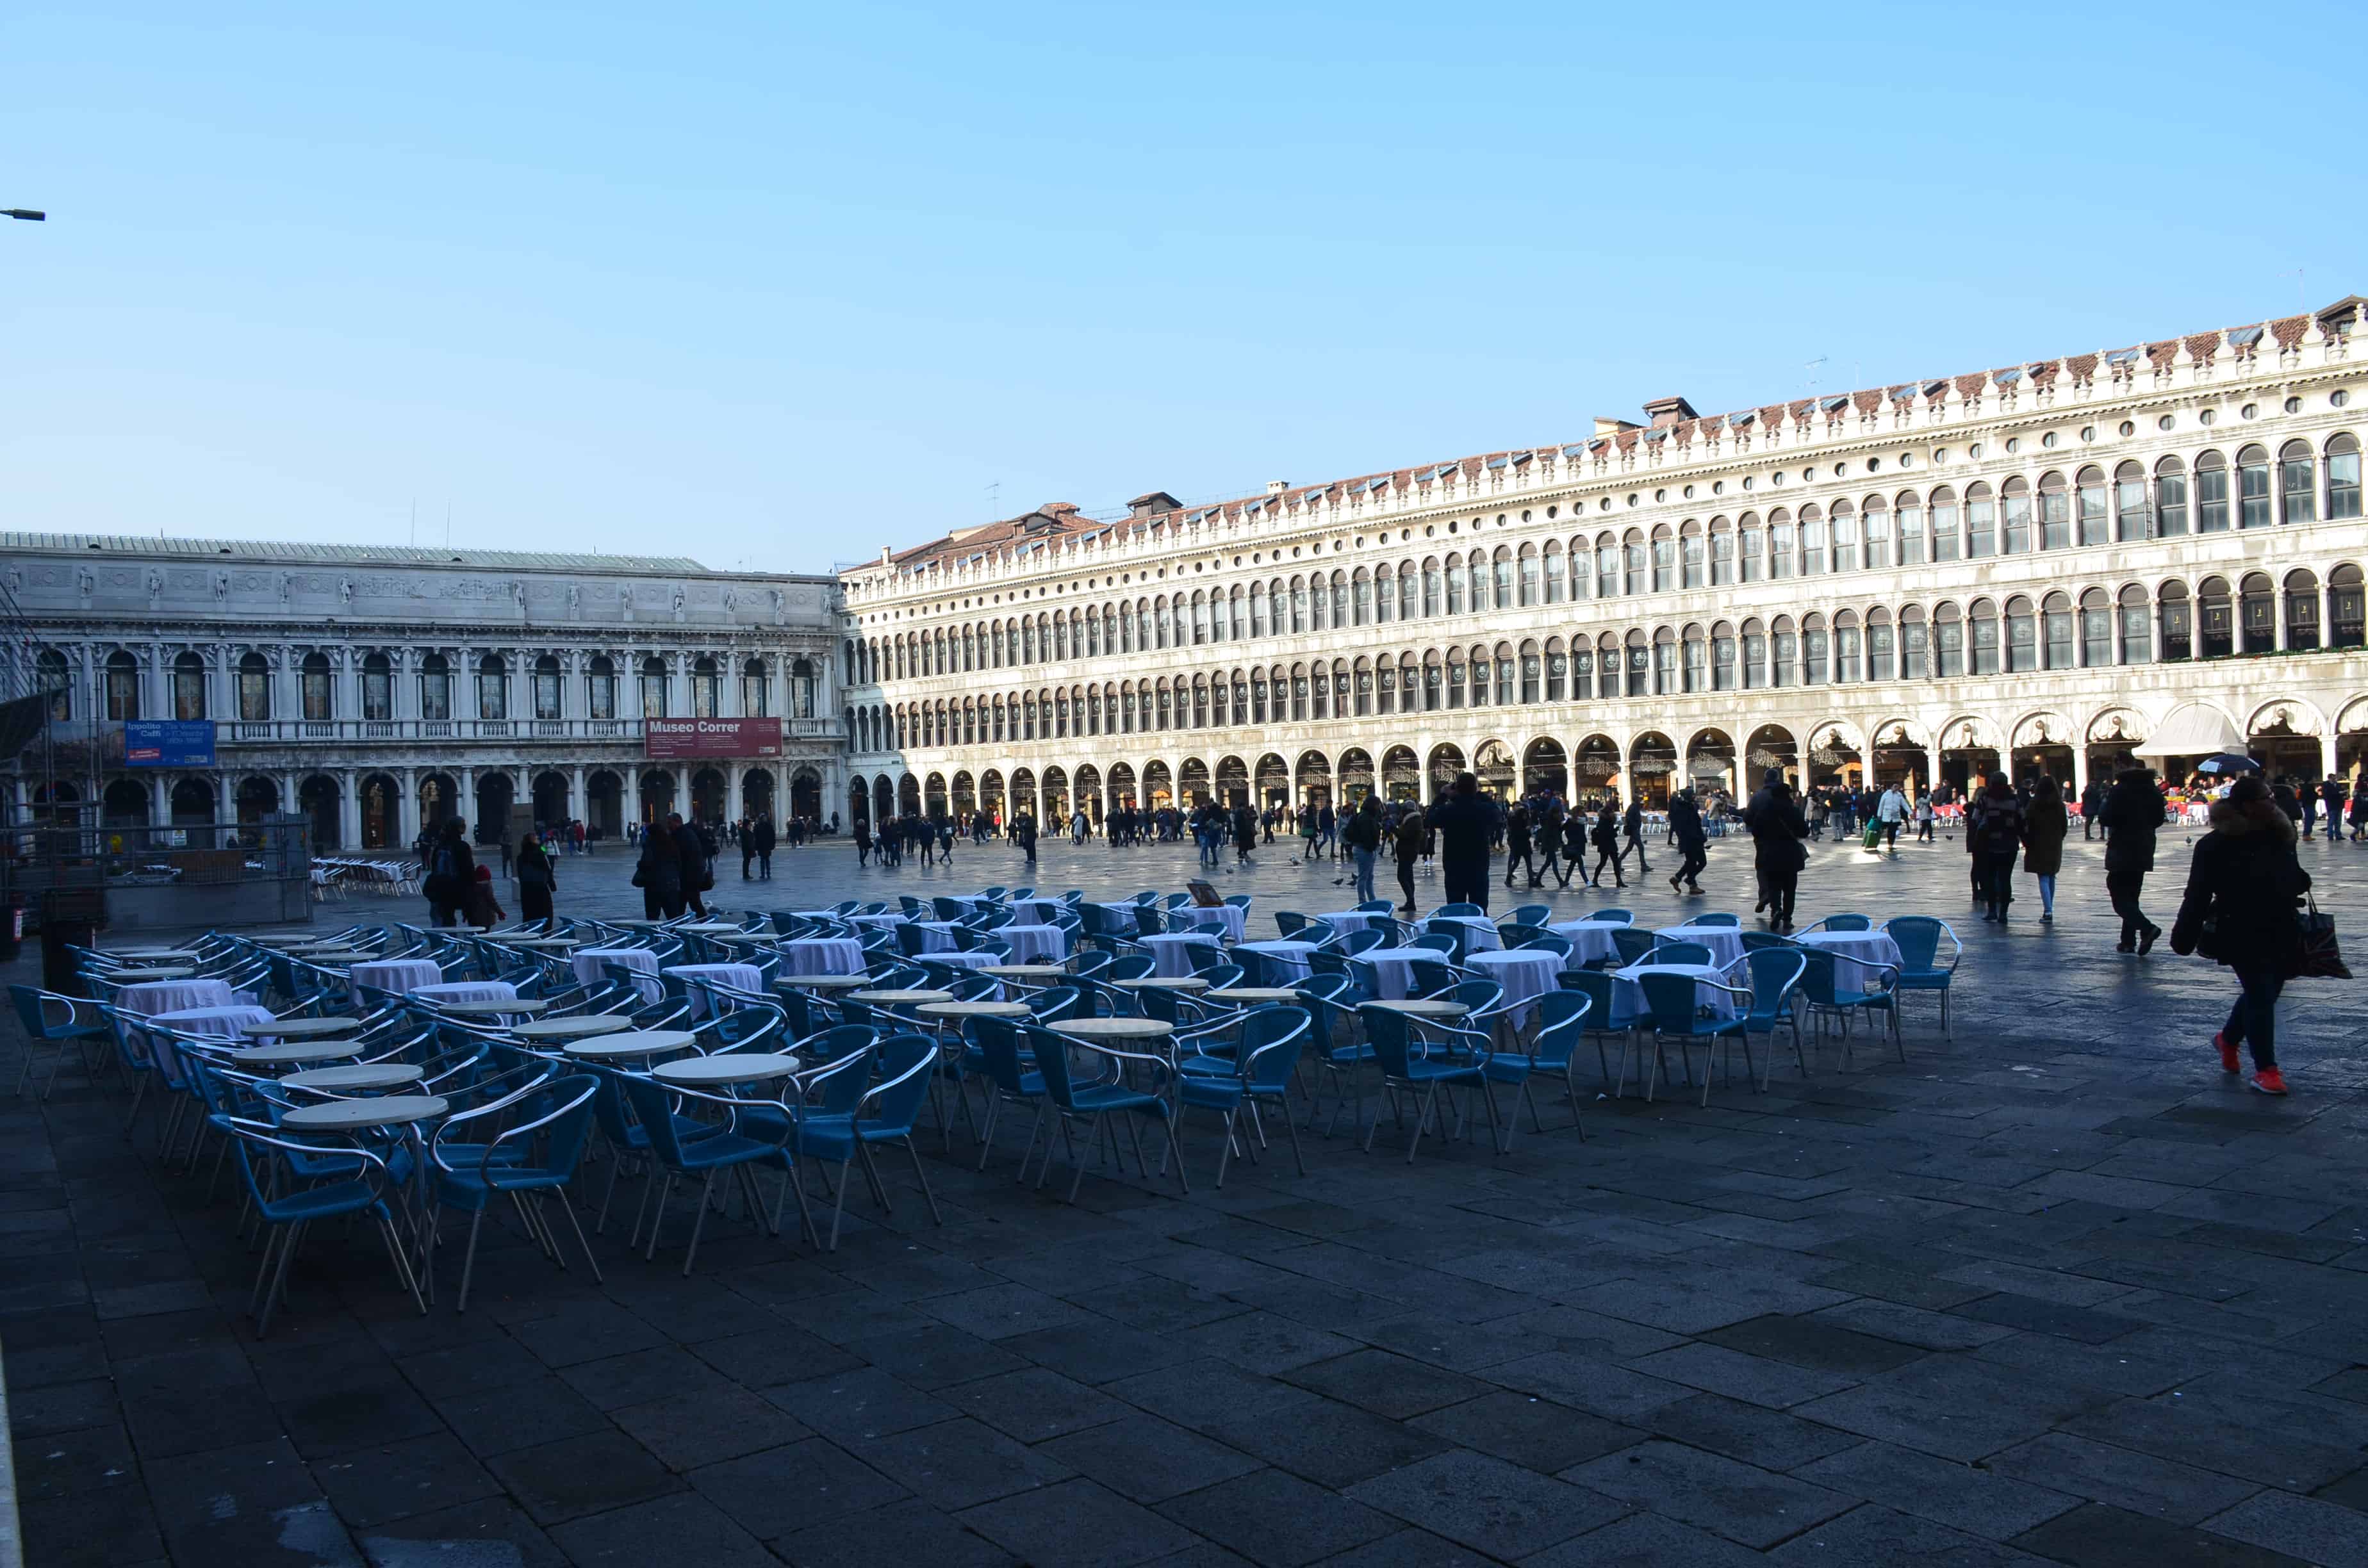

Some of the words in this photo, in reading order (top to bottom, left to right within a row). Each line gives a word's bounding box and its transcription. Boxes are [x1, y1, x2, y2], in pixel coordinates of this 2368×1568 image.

[128, 723, 161, 731] Ippolito
[650, 721, 695, 733] Museo
[698, 721, 741, 733] Correr
